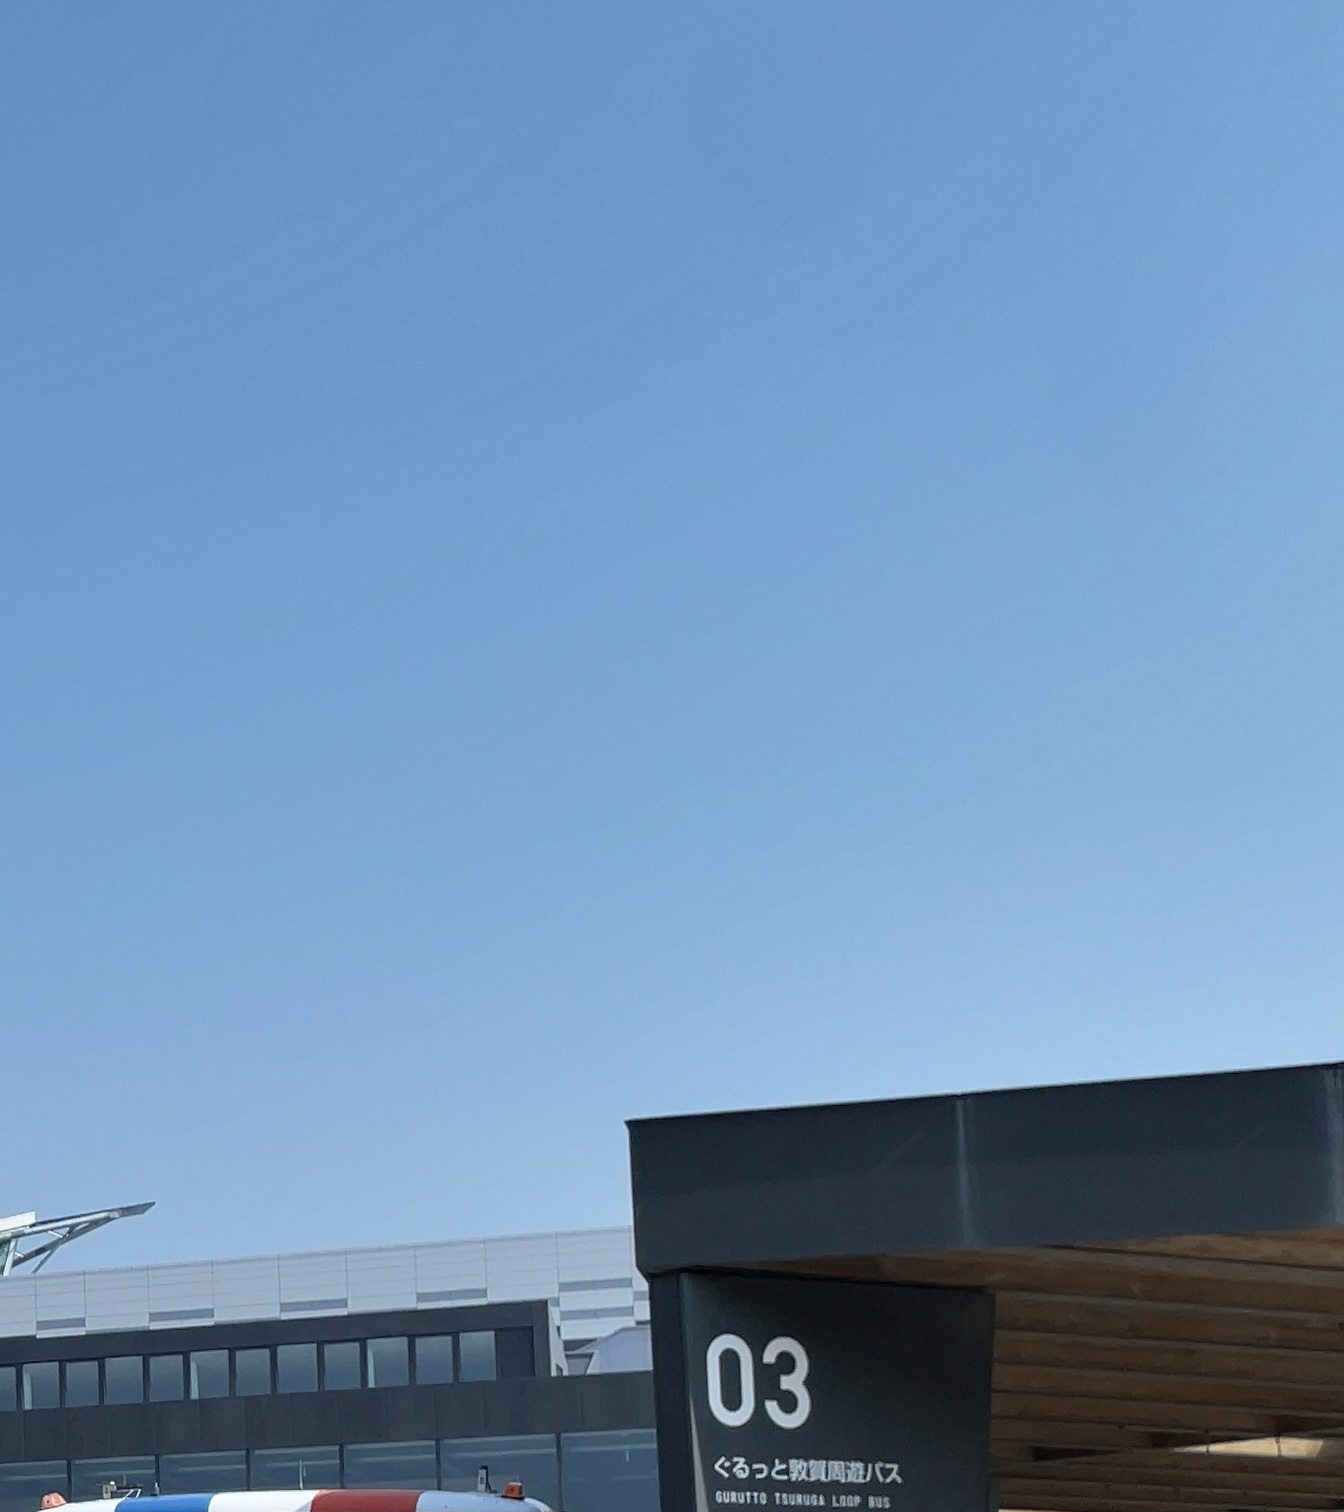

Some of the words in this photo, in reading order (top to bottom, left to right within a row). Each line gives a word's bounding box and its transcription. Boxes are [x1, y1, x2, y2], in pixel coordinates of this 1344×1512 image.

[706, 1333, 811, 1429] 03
[714, 1456, 903, 1484] ぐるっと敦賀周遊バス
[715, 1490, 768, 1504] GURUTTO
[774, 1492, 826, 1506] TSURUGA
[832, 1494, 862, 1508] LOOP
[868, 1495, 891, 1509] BUS
